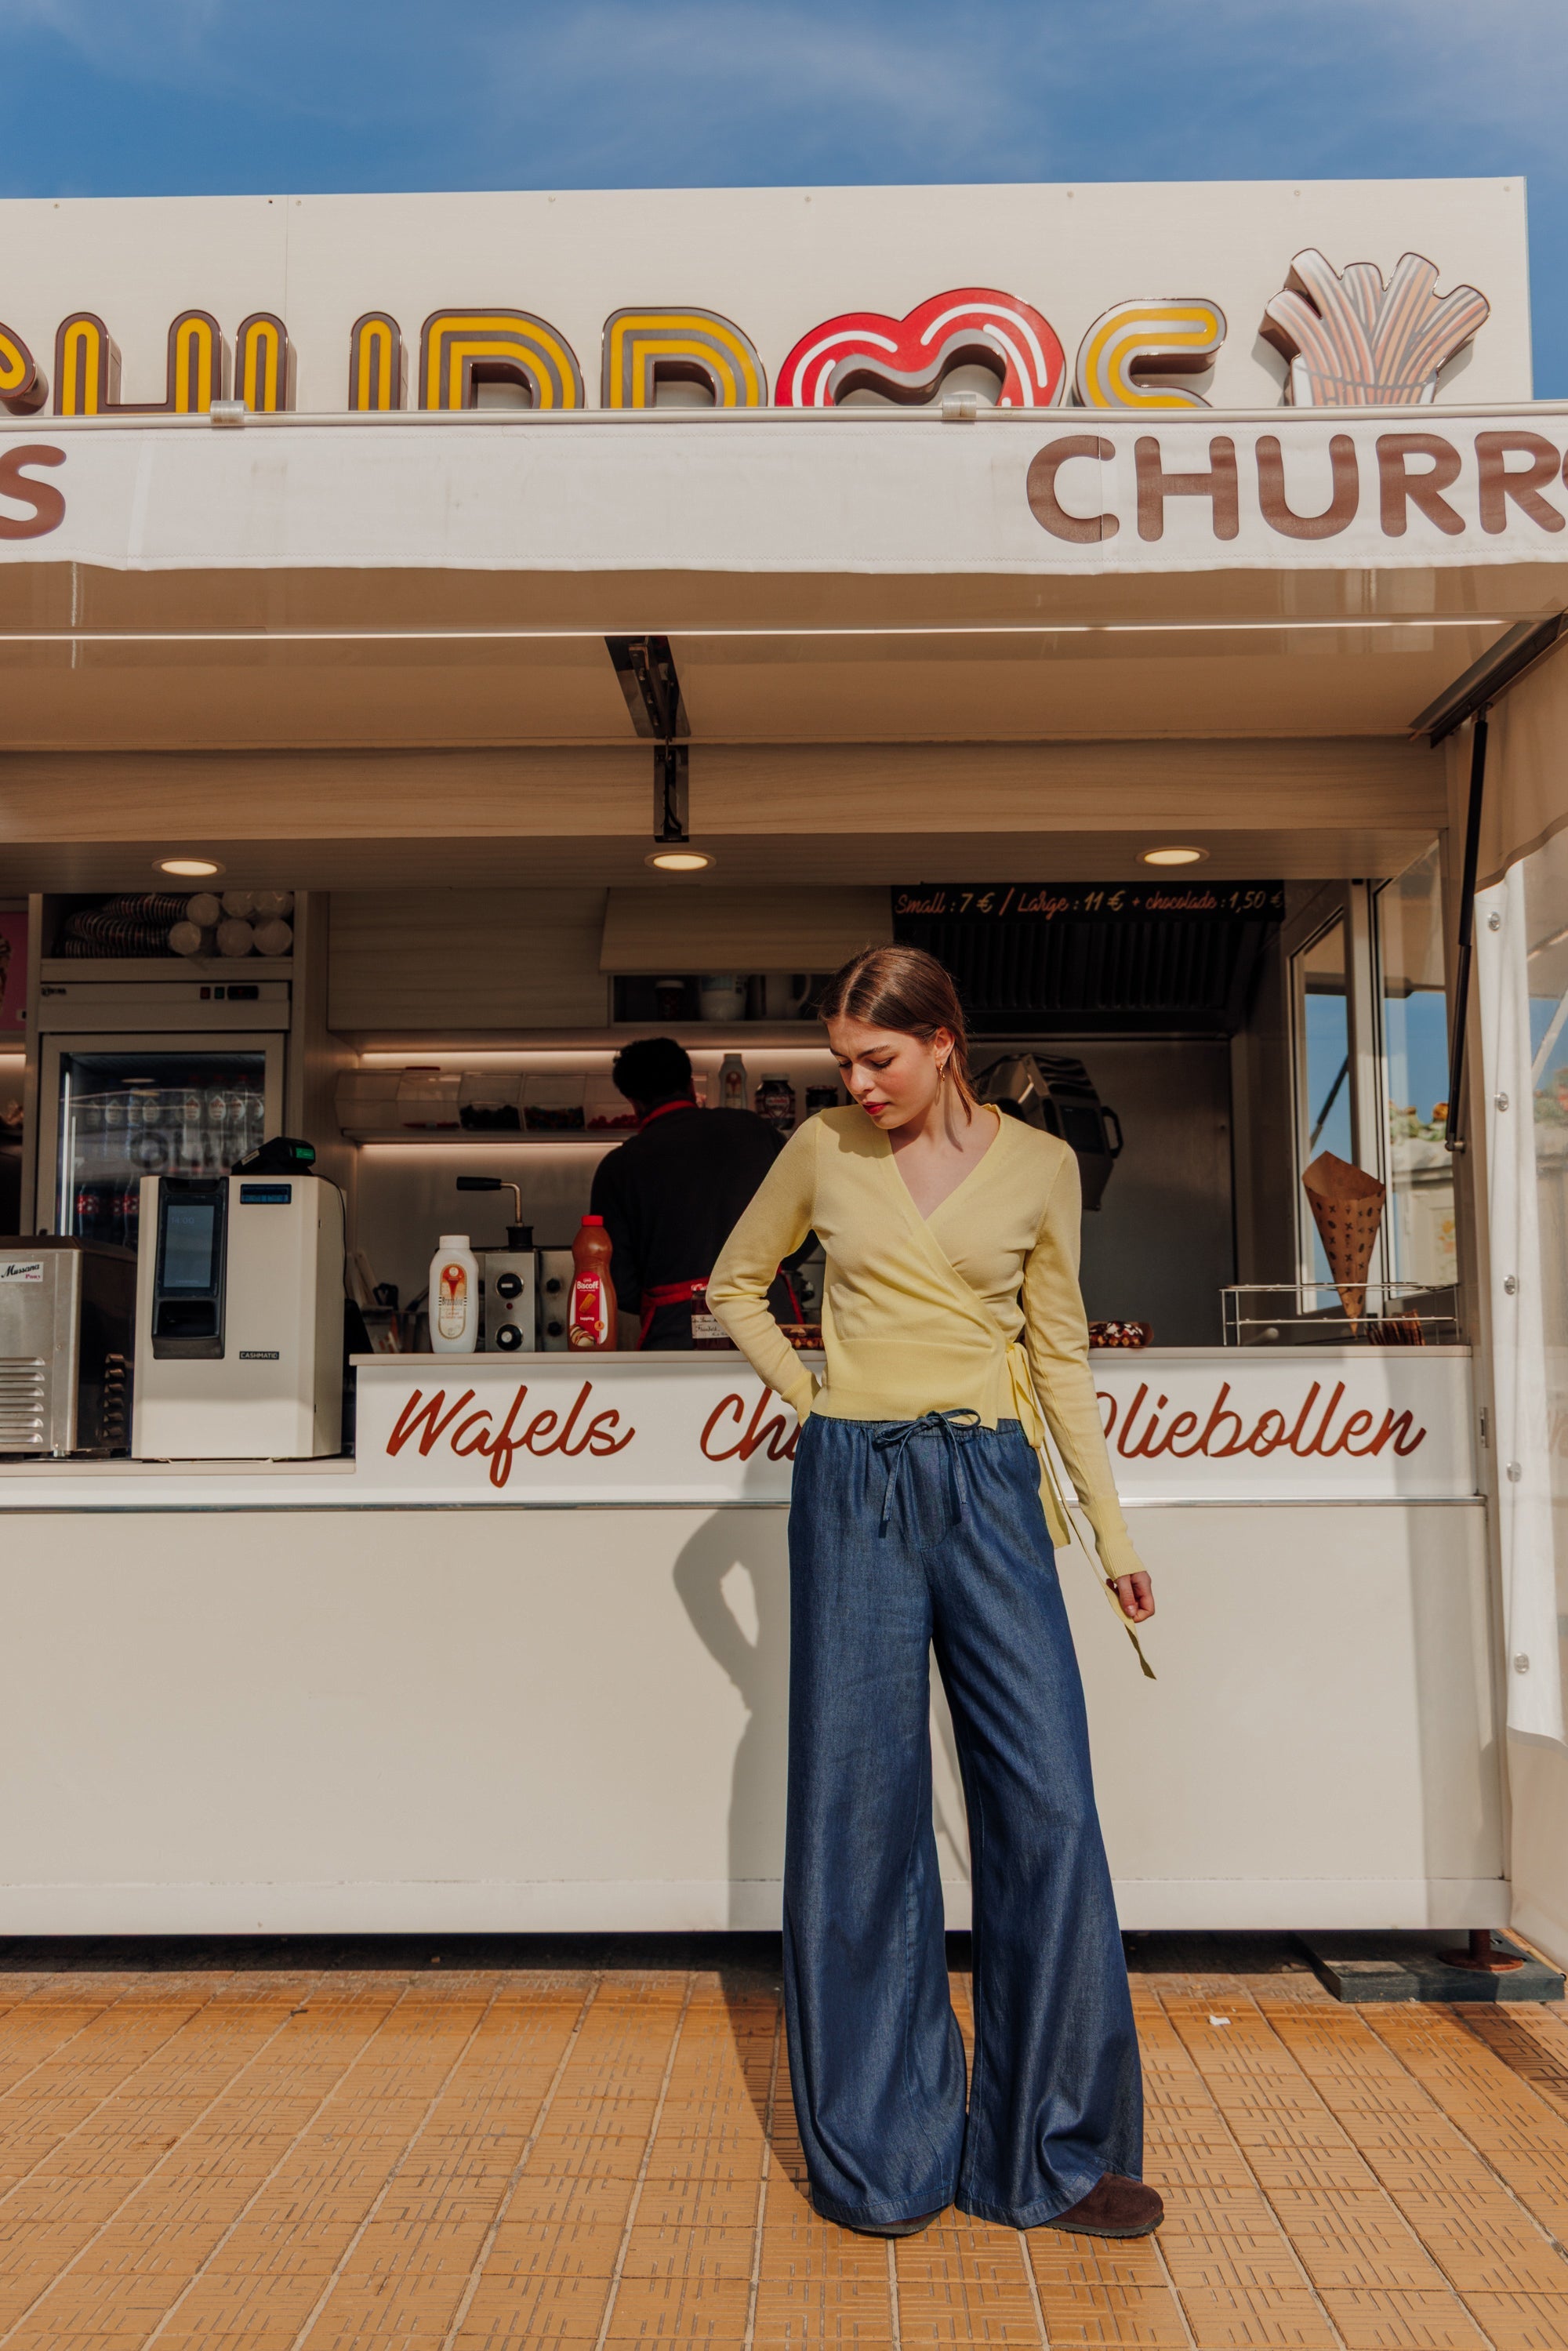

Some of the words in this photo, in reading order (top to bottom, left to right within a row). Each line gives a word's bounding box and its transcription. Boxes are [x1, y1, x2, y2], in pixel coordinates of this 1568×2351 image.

[1026, 431, 1568, 543] CHURR
[895, 892, 946, 914] Small
[1145, 890, 1218, 909] chocolade
[1, 1264, 40, 1279] Mussana
[576, 1280, 599, 1290] Biscoff
[386, 1380, 636, 1488] Wafels
